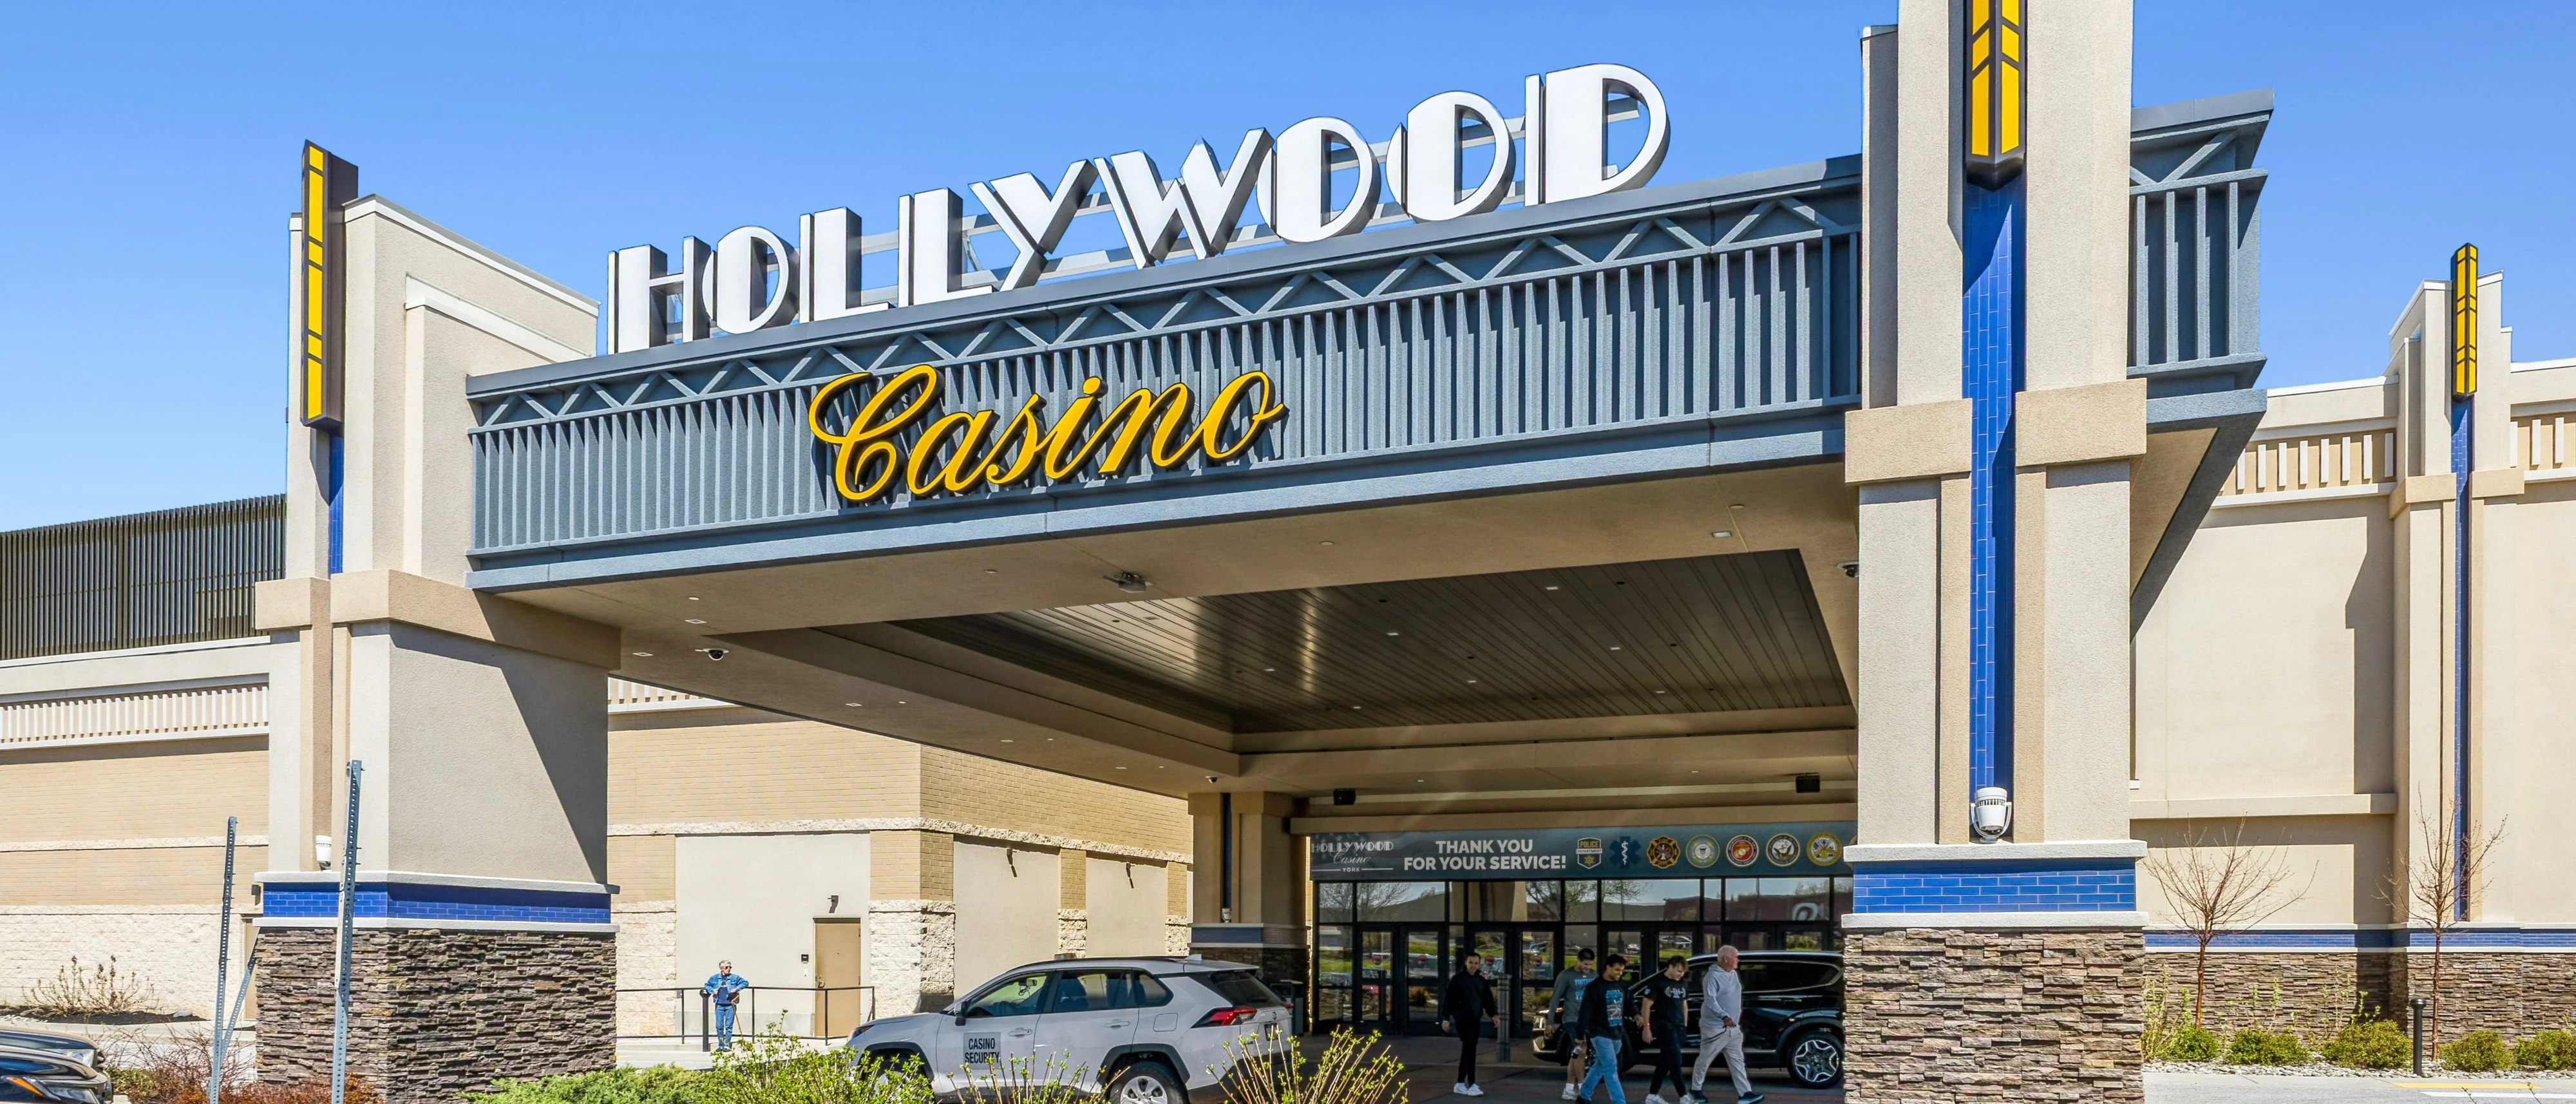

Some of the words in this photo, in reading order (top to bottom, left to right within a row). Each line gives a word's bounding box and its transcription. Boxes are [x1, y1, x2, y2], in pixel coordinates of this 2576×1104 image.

[607, 63, 1671, 355] HOLLYWOOD
[808, 365, 1287, 502] Casino
[1311, 841, 1394, 853] HOLLYWOOD
[1435, 840, 1494, 853] THANK
[1497, 839, 1533, 853] YOU
[1330, 848, 1369, 864] Casino
[1404, 857, 1436, 870] FOR
[1439, 857, 1486, 870] YOUR
[1490, 855, 1566, 870] SERVICE!
[969, 1038, 996, 1050] CASINO
[965, 1052, 999, 1063] SECURITY
